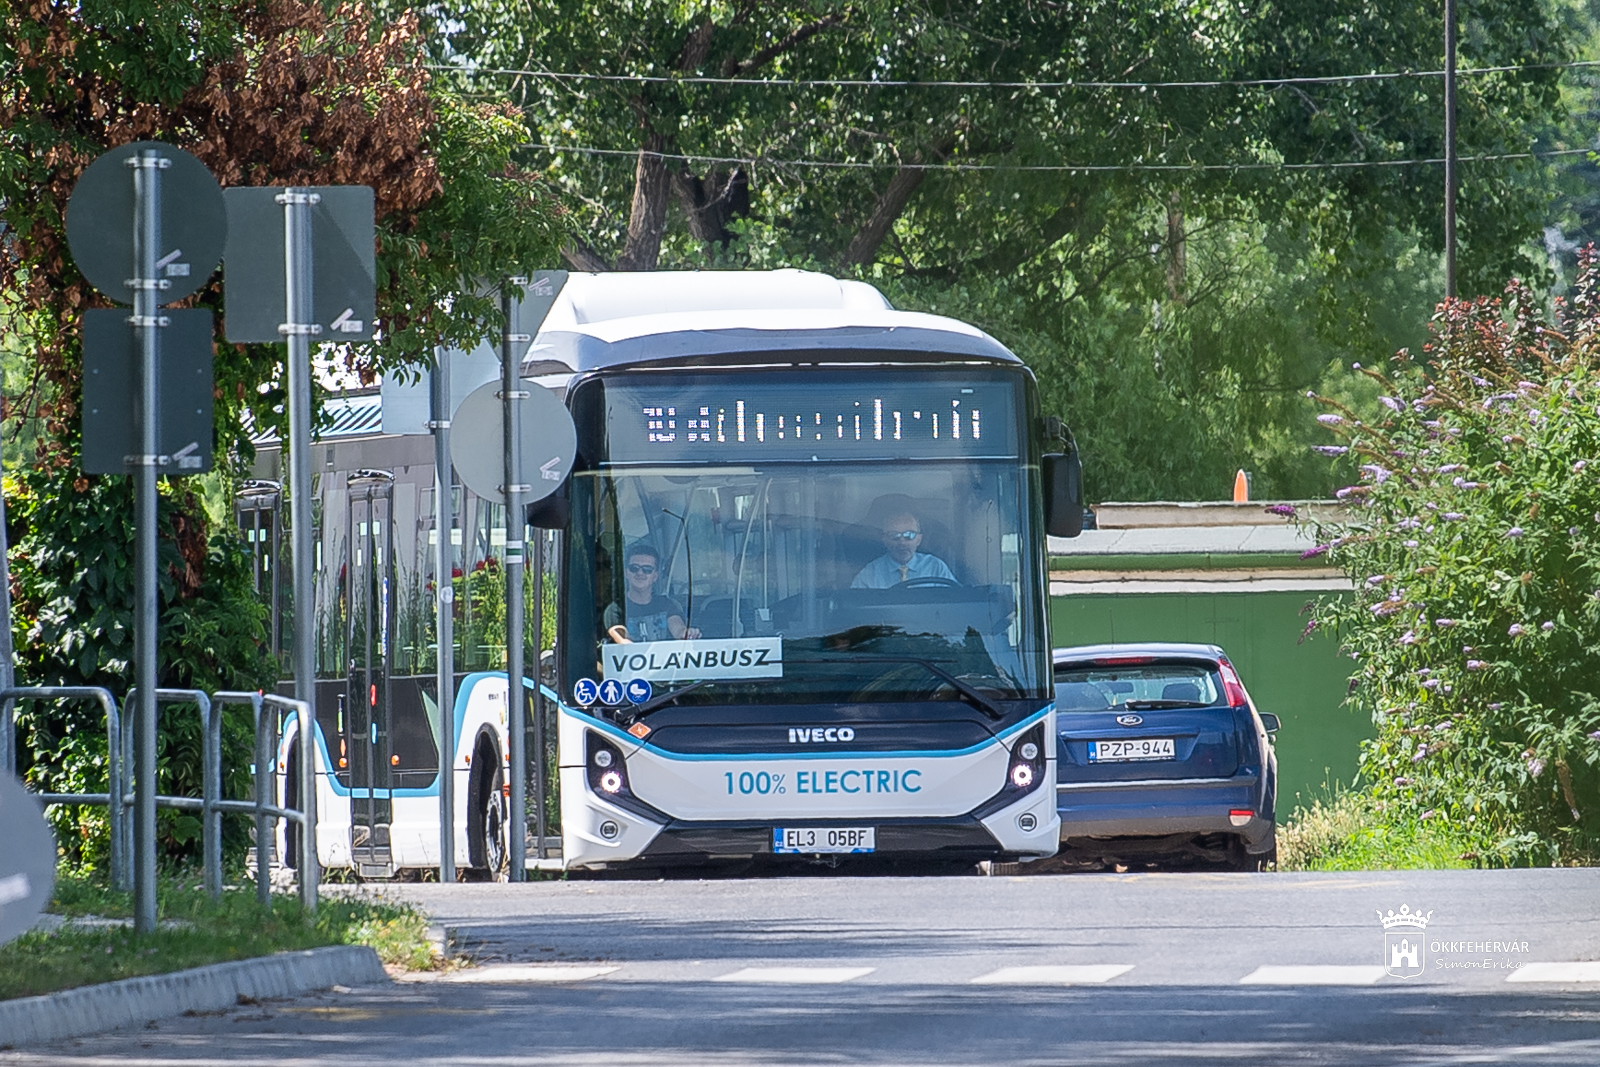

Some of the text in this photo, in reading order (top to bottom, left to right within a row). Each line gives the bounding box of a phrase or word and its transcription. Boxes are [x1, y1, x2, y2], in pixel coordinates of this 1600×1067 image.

[788, 727, 855, 743] IVECO
[1100, 741, 1171, 757] PZP-944
[724, 770, 922, 795] 100% ELECTRIC
[787, 829, 867, 847] EL3 05BF
